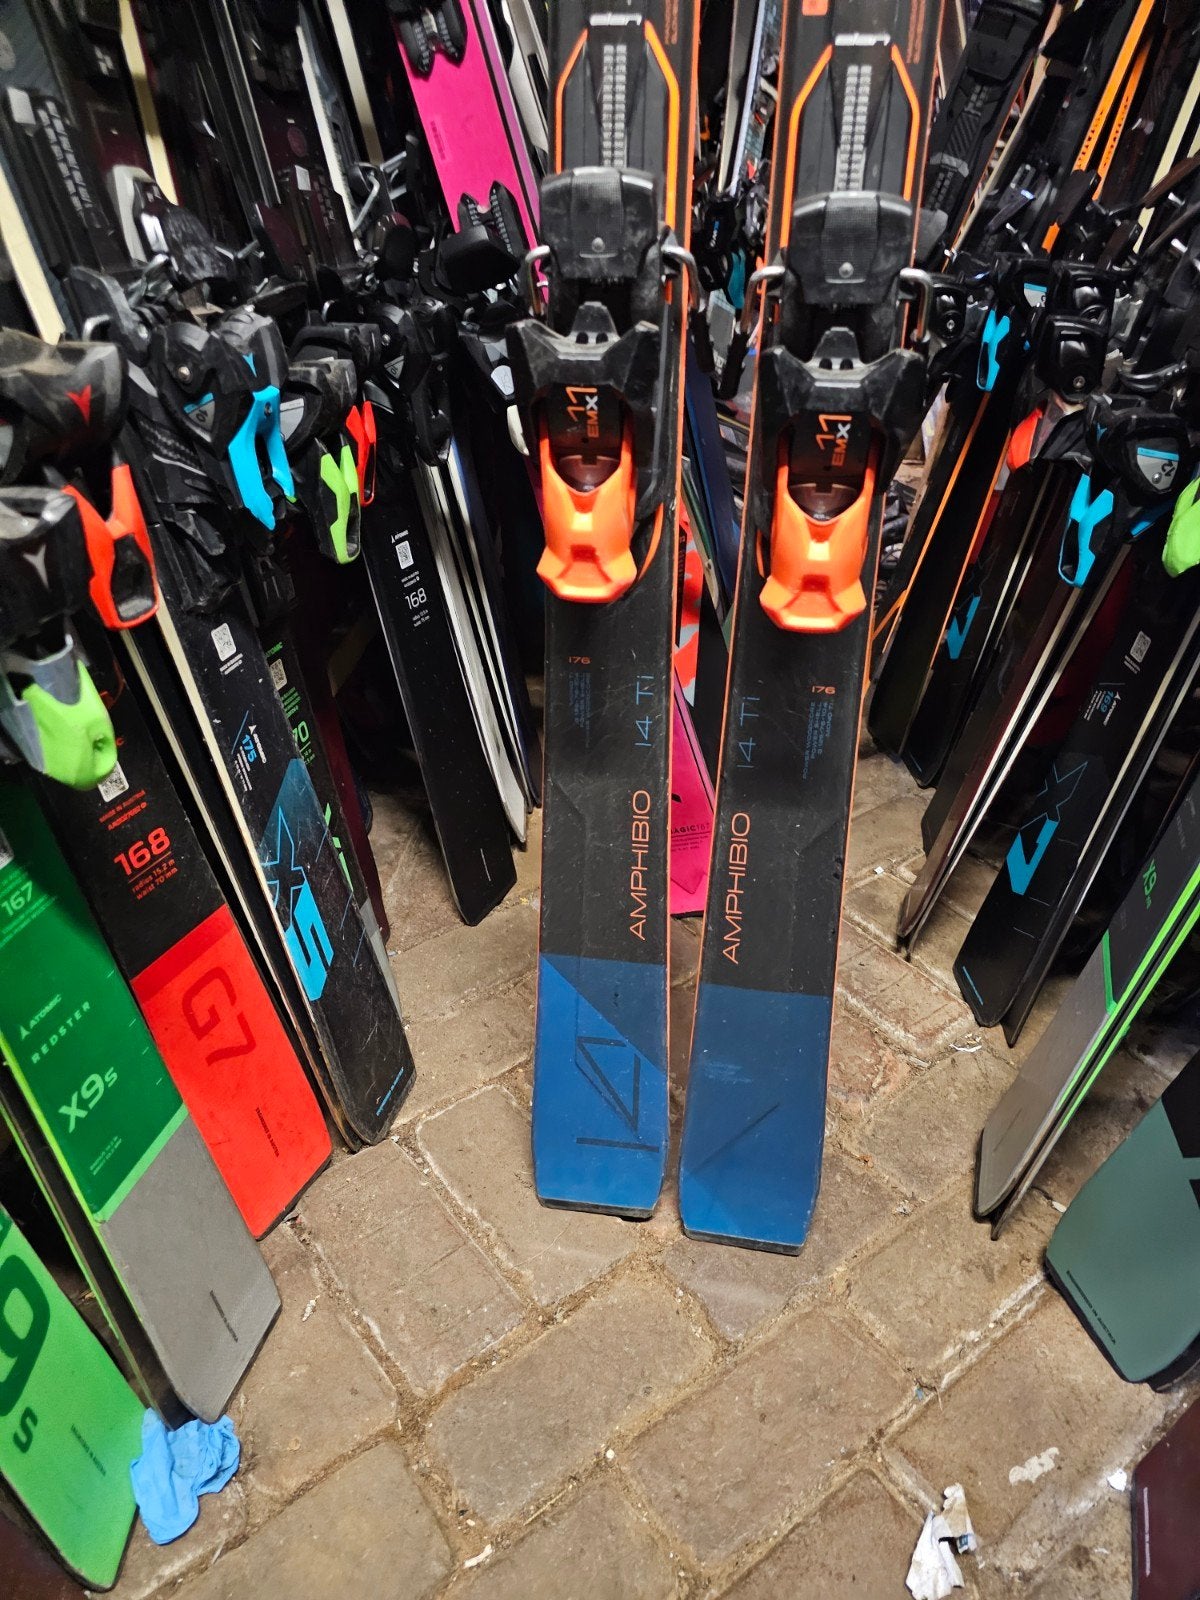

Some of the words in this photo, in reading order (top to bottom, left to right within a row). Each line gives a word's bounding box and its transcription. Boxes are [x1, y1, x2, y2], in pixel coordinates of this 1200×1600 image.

[565, 387, 597, 422] 11
[816, 414, 852, 450] 11
[404, 587, 428, 610] 168
[811, 685, 836, 695] 176
[241, 734, 258, 763] 175
[113, 827, 171, 876] 168
[629, 789, 651, 941] AMPHIBIO
[1, 880, 33, 916] 167
[722, 812, 751, 965] AMPHIBIO
[29, 994, 62, 1029] ATOMIC
[31, 1001, 91, 1064] REDSTER
